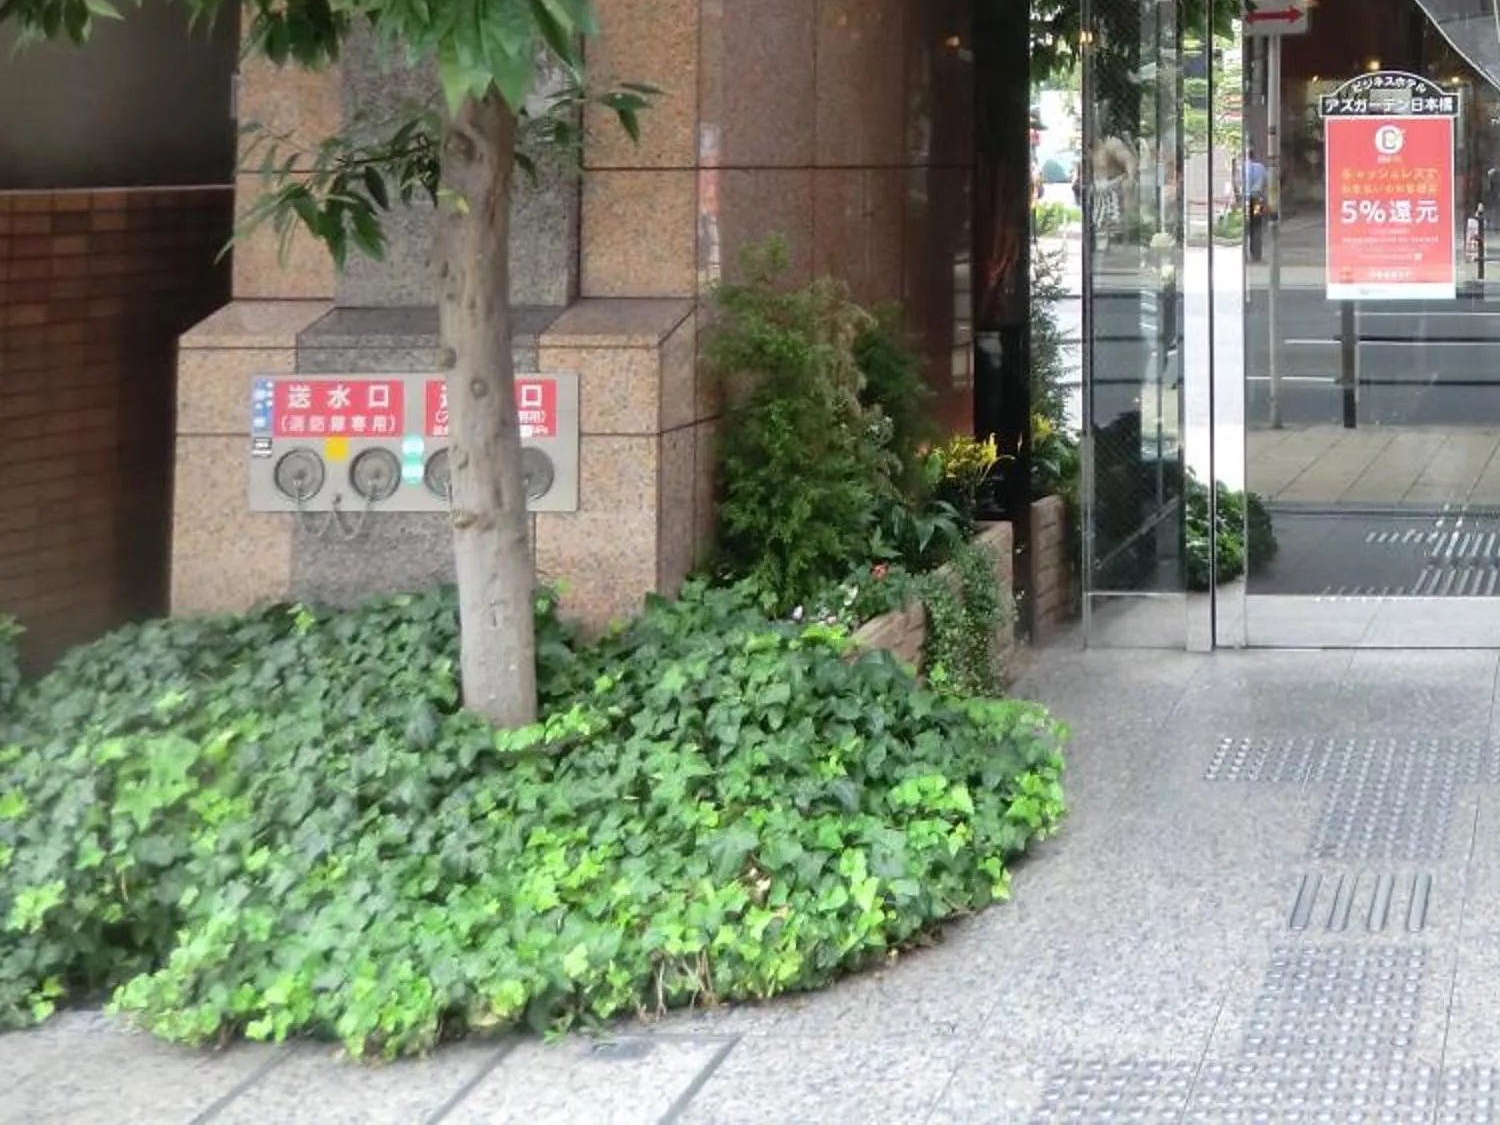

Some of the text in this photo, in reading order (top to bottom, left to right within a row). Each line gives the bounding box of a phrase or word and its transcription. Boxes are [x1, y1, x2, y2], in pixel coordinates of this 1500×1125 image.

[1352, 75, 1427, 93] ビジネスホテル
[1325, 96, 1453, 114] アズガーデン日本橋
[1341, 199, 1439, 224] 5%還元
[287, 384, 391, 410] 送水口
